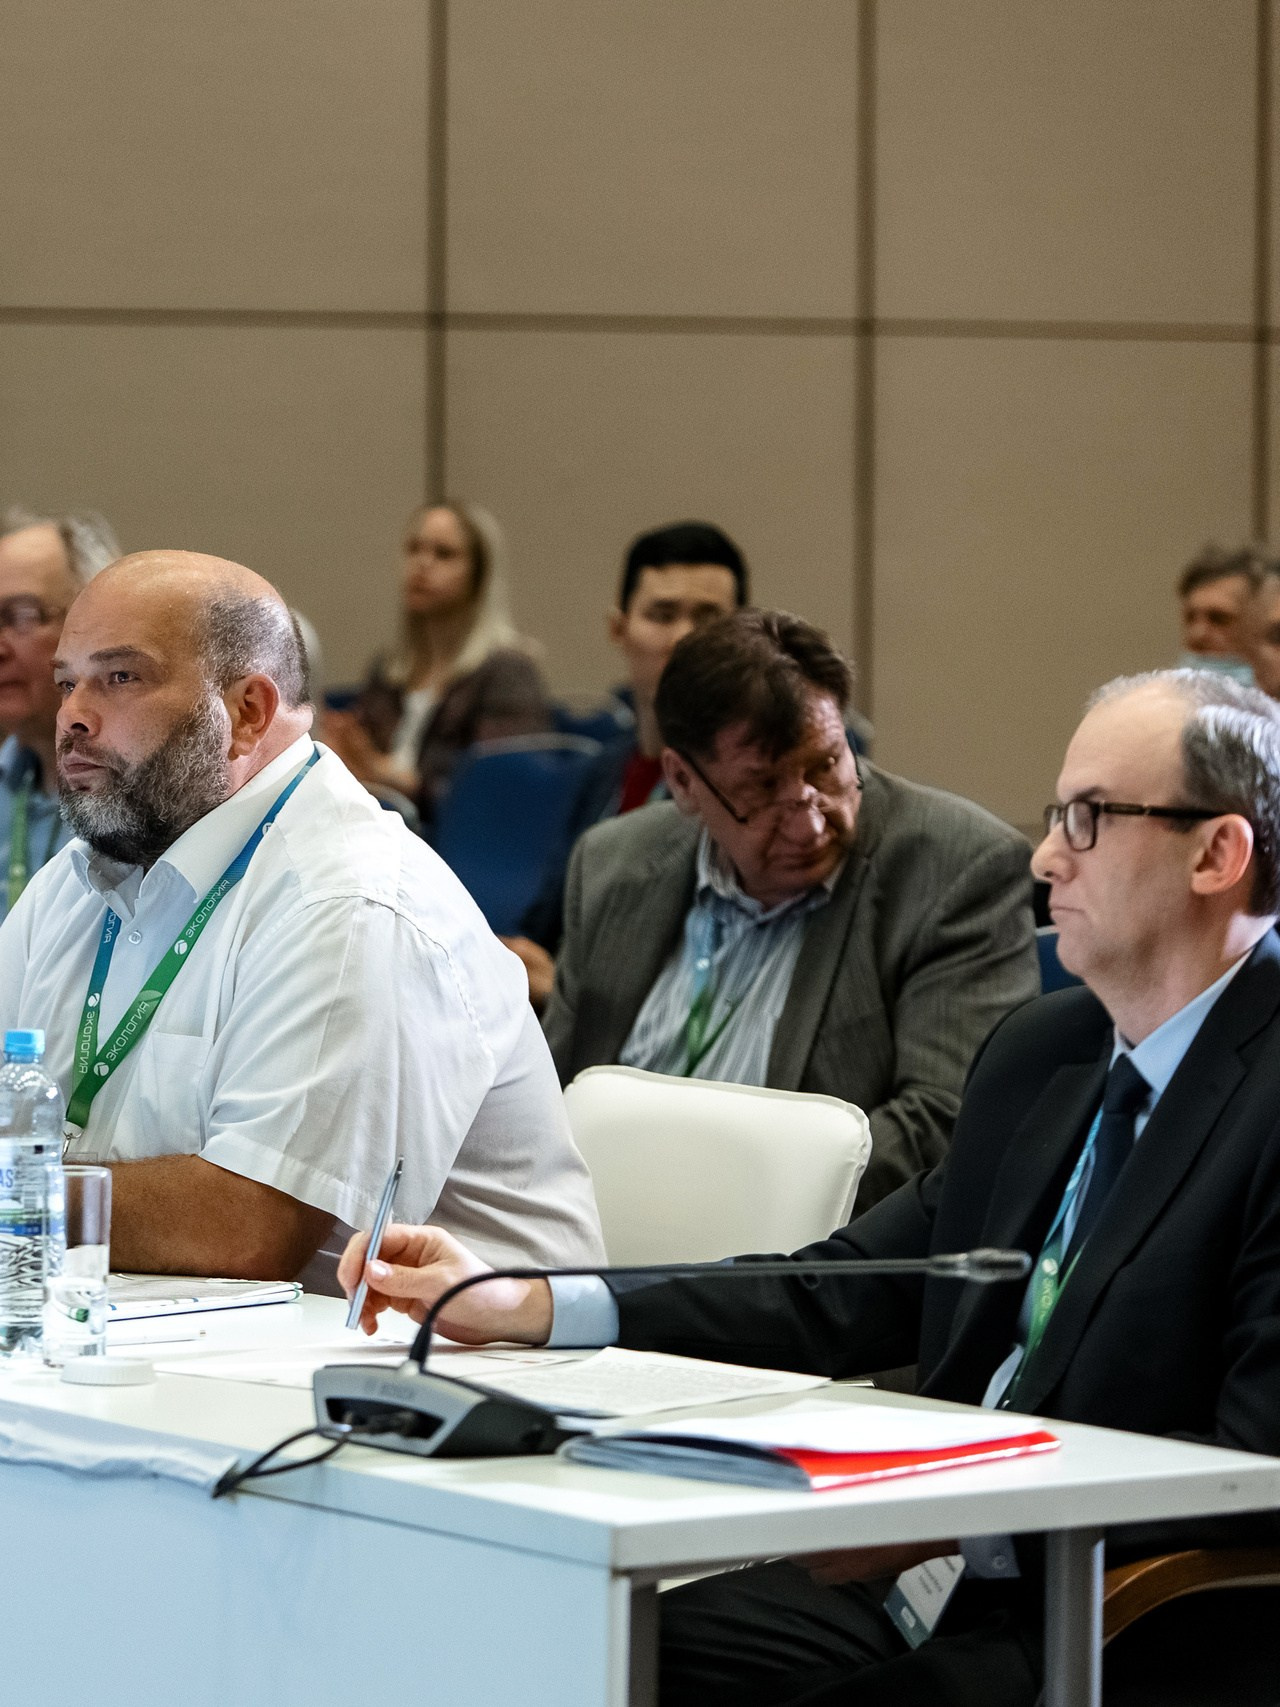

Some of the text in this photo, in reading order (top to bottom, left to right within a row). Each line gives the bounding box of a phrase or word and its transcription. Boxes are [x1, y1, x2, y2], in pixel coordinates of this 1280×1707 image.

[104, 911, 117, 944] ОГИЯ
[185, 879, 230, 938] ЭКОЛОГИЯ
[79, 1011, 96, 1074] ЭКОЛОГИЯ
[106, 1001, 150, 1062] ЭКОЛОГИЯ
